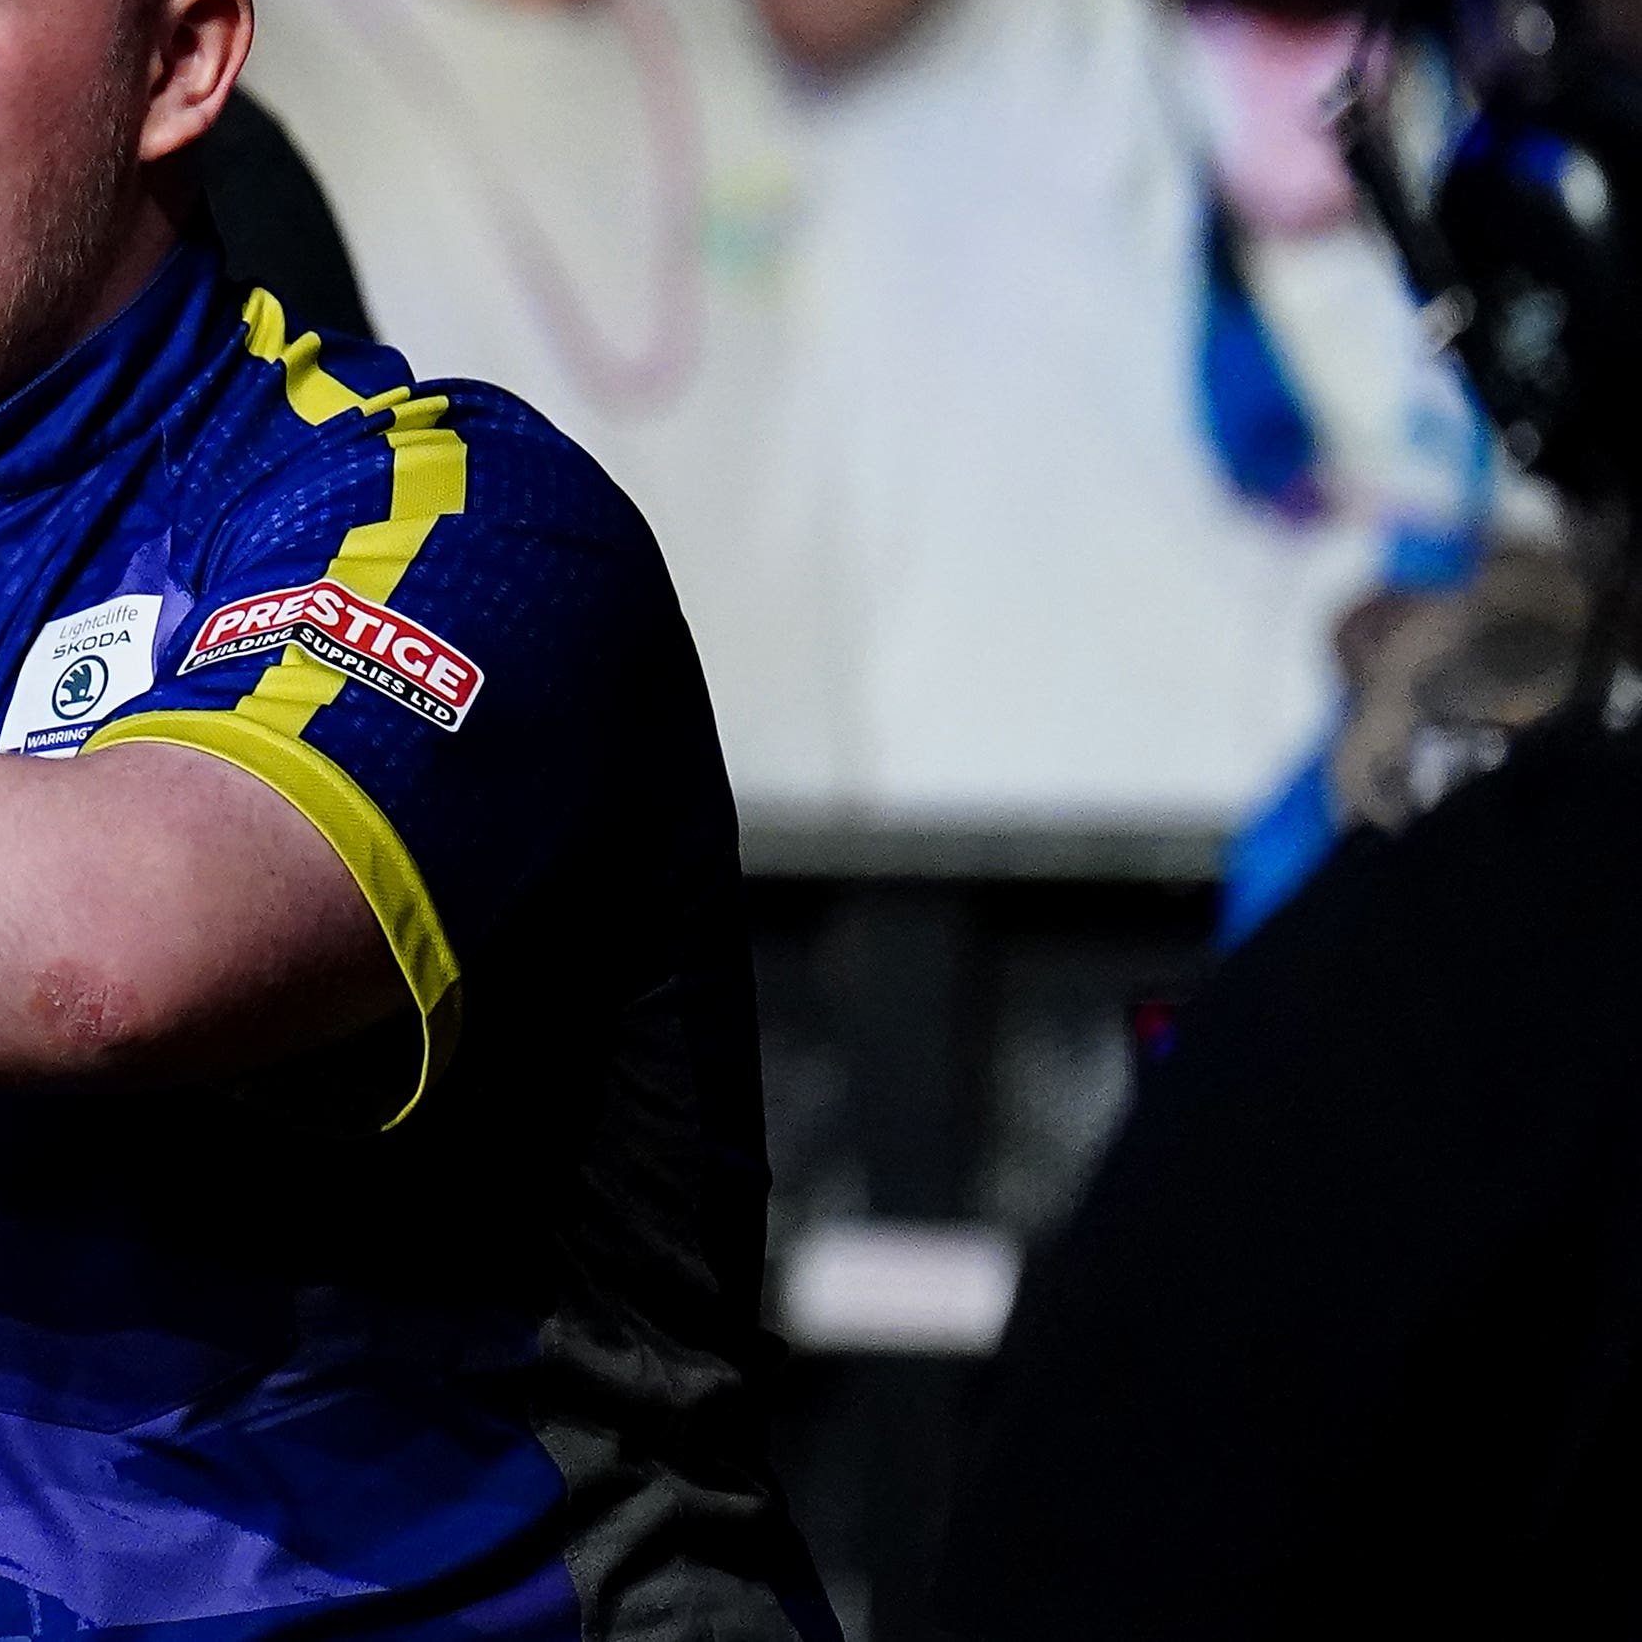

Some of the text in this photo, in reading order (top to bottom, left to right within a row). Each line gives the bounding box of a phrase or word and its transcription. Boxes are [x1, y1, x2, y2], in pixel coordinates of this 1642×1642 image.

[59, 604, 139, 639] Lightcliffe
[206, 589, 468, 700] PRESTIGE
[192, 626, 451, 721] BUILDING SUPPLIES LTD
[27, 726, 94, 749] WARRING
